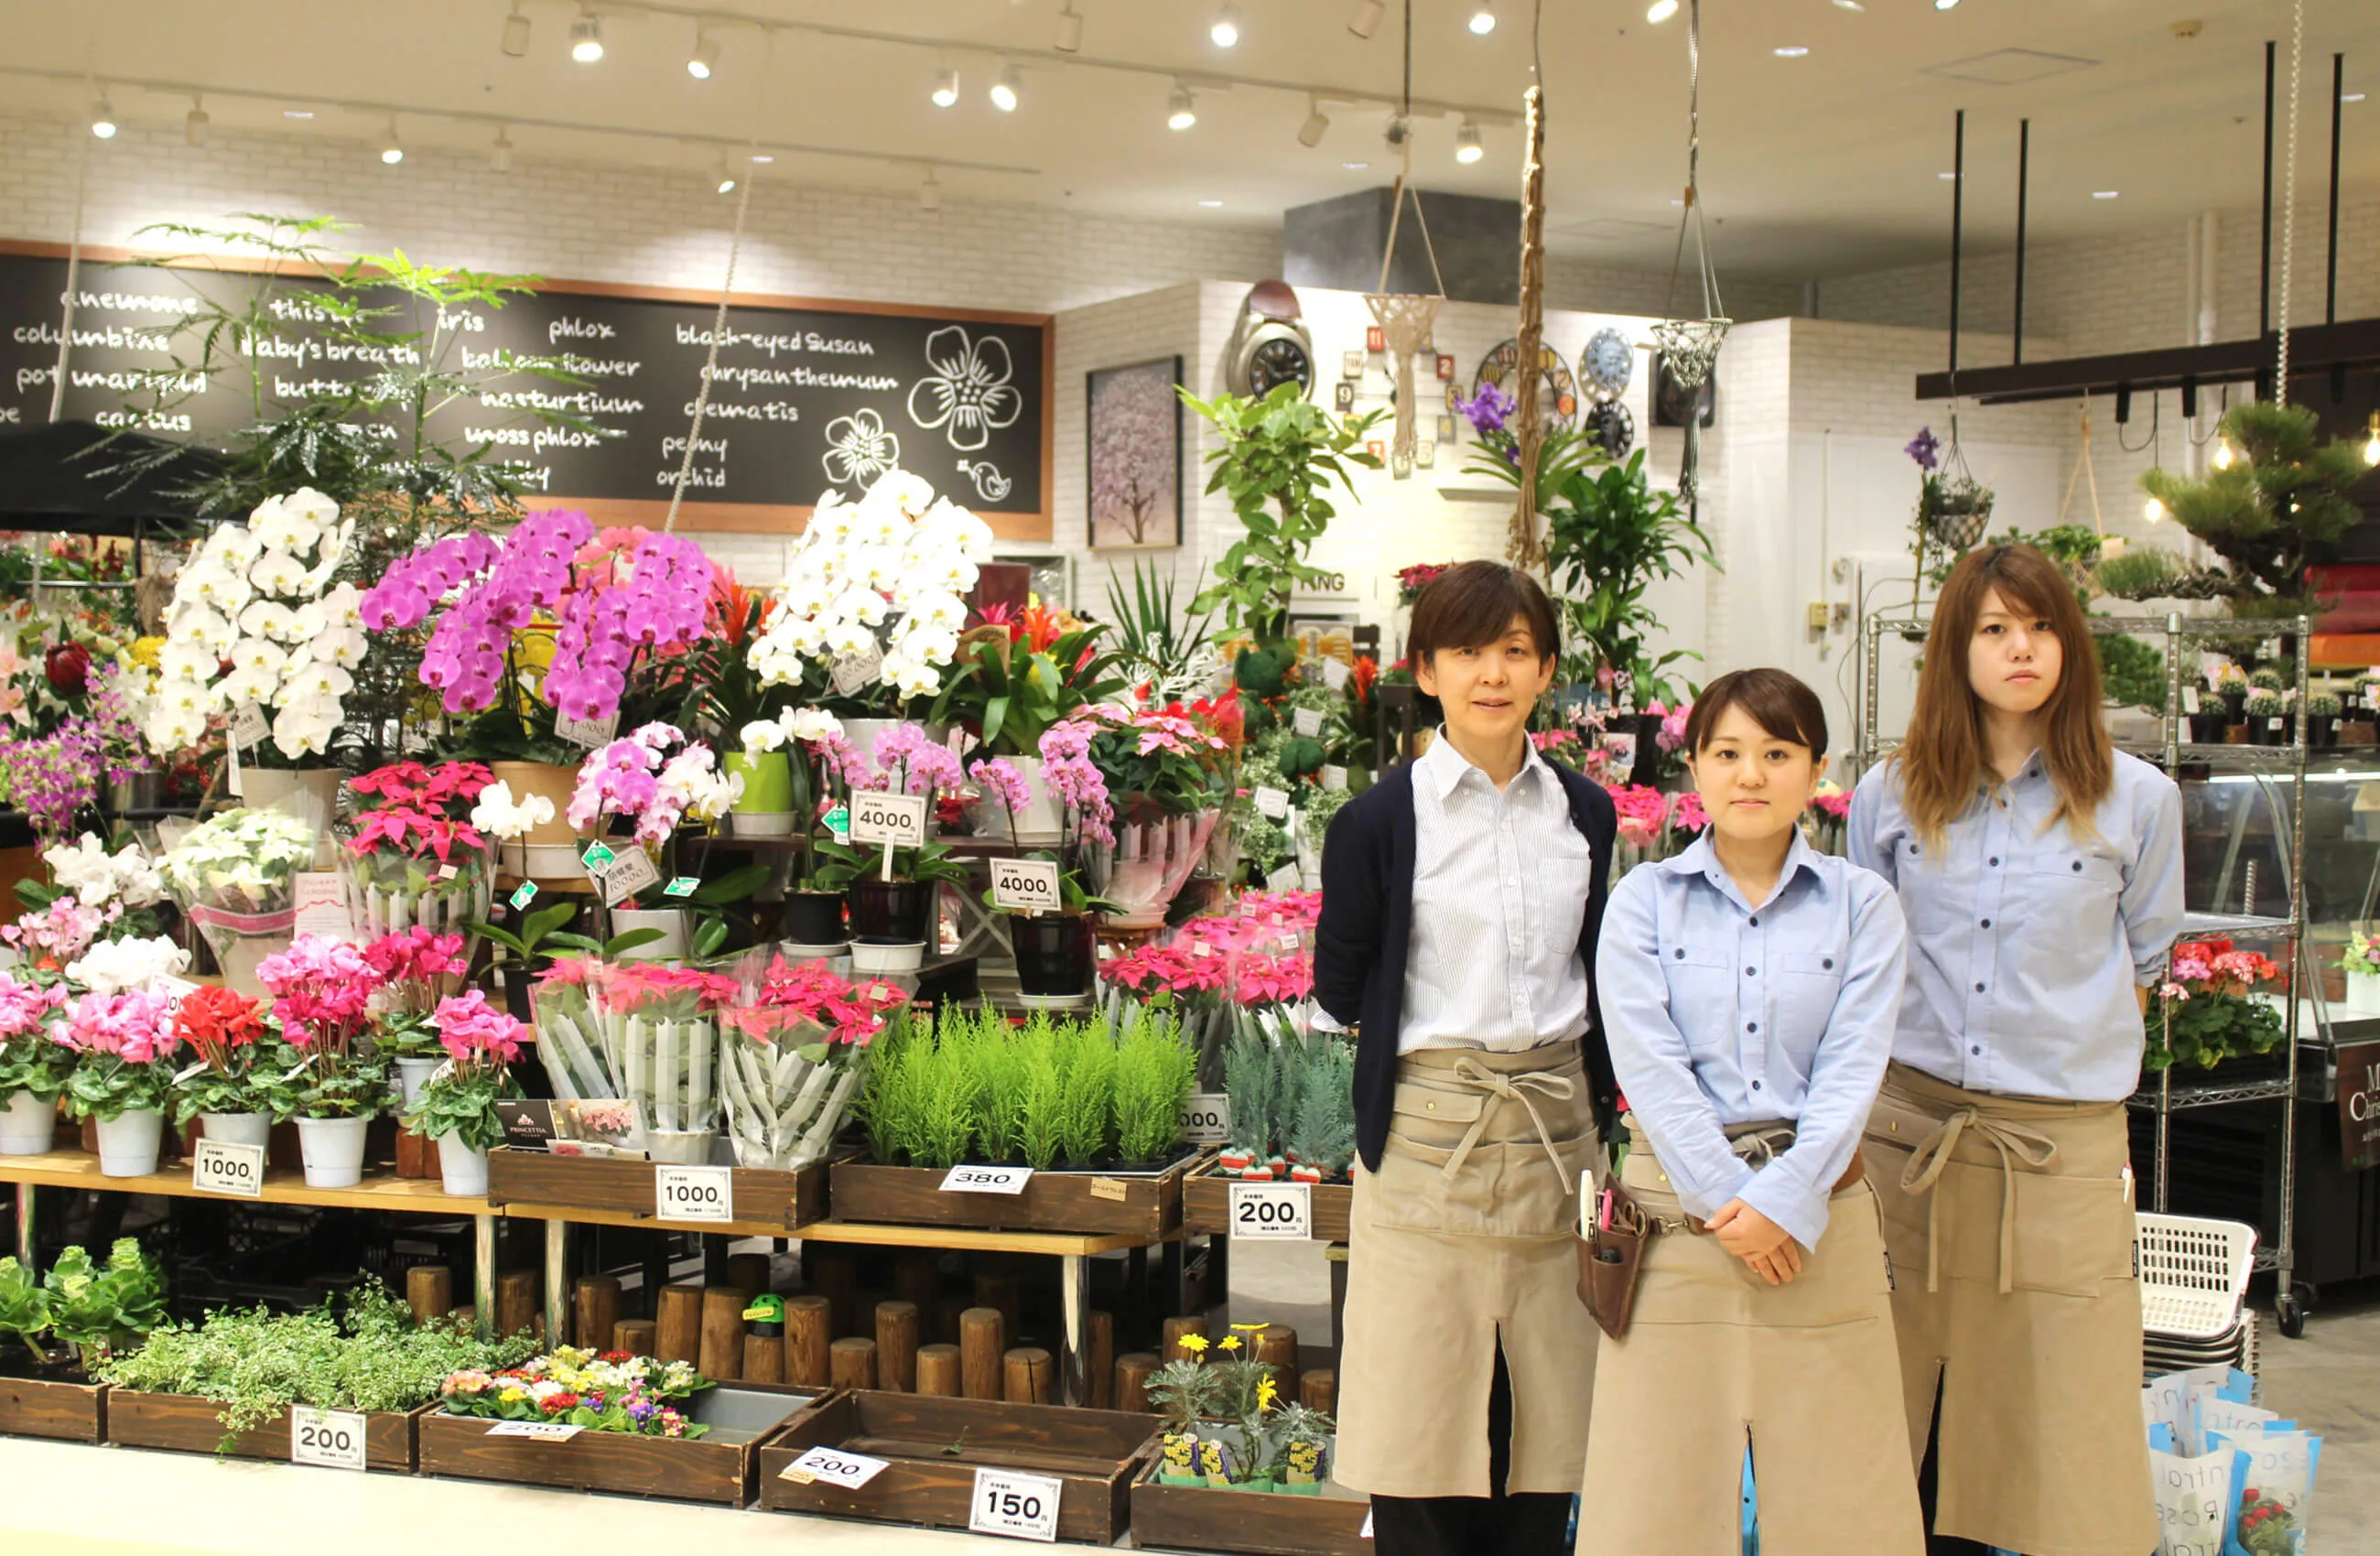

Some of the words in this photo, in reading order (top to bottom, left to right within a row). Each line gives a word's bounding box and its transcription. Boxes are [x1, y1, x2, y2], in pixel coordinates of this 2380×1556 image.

[60, 291, 199, 315] anemone
[438, 308, 484, 331] iris
[549, 317, 615, 344] phlox
[14, 322, 169, 351] columbine
[676, 323, 801, 358] black-eyed
[806, 332, 874, 355] Susan
[327, 339, 420, 365] breath
[700, 364, 899, 392] chrysanthemum
[481, 390, 644, 413] nasturtium
[684, 397, 799, 422] clematis
[464, 427, 529, 445] moss
[534, 427, 600, 454] phlox
[656, 467, 726, 488] orchid
